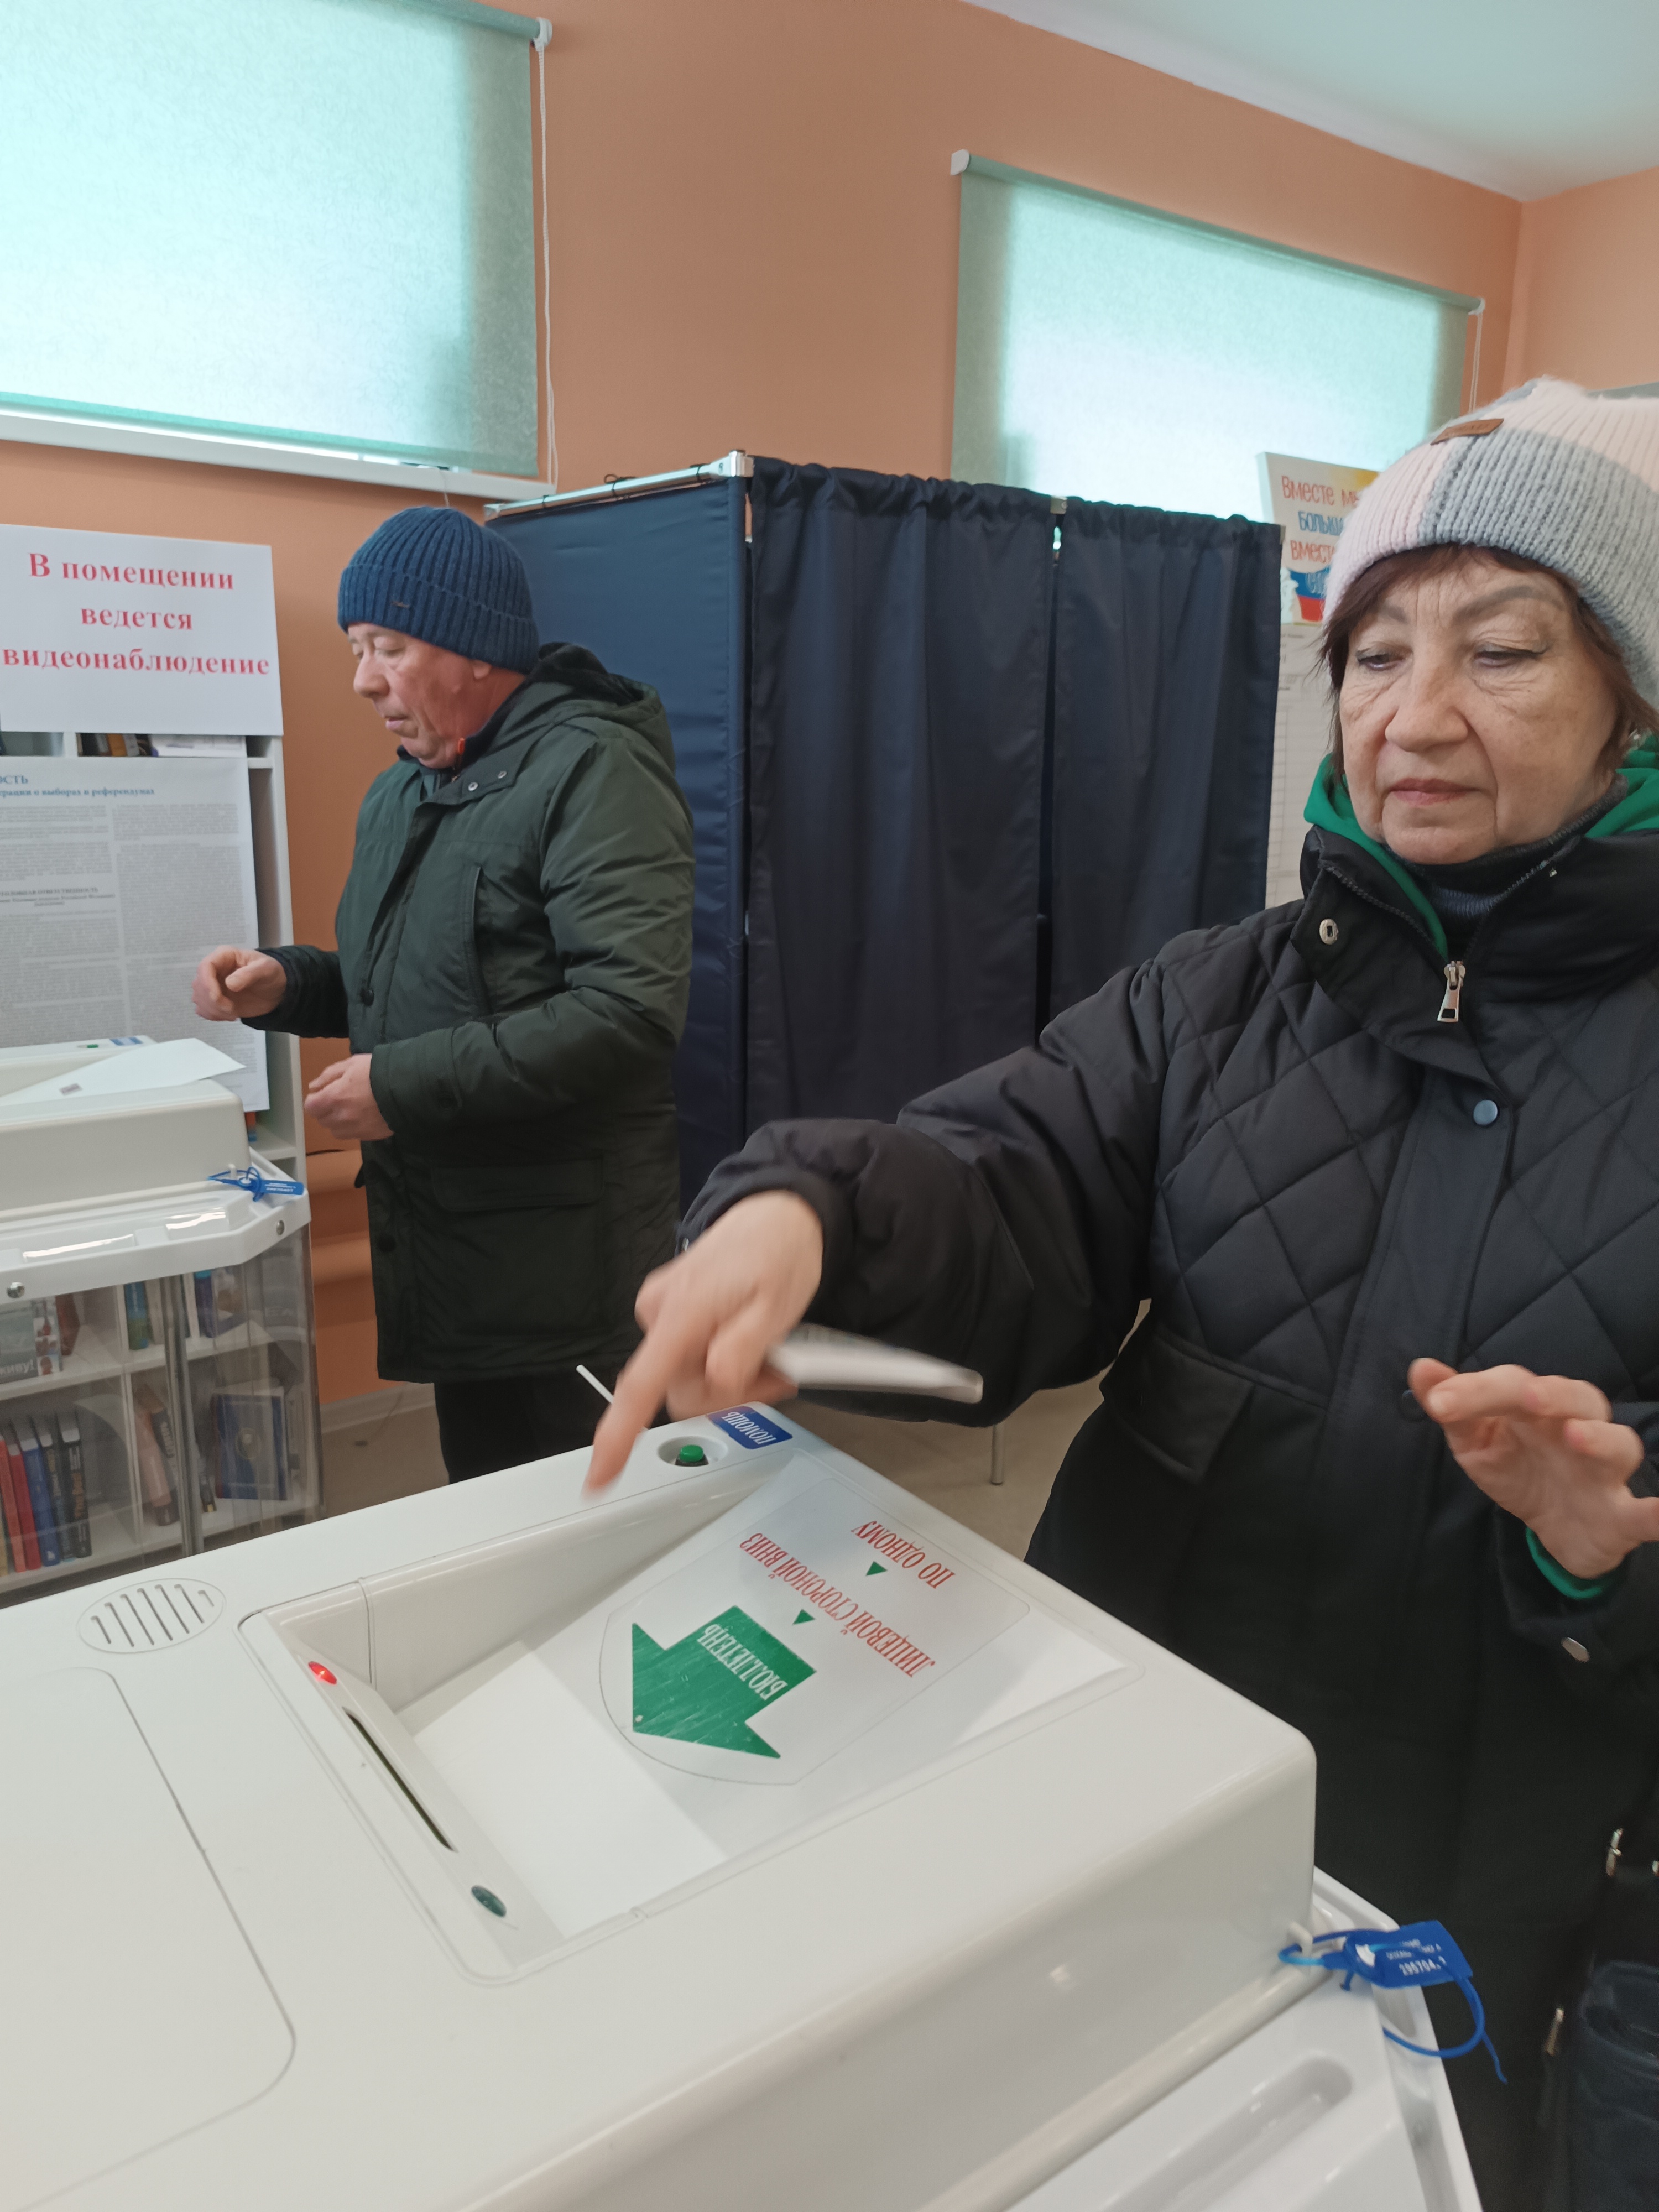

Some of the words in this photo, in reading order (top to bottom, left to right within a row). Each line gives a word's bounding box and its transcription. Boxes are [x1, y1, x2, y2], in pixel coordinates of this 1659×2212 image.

[29, 552, 51, 577] В
[62, 562, 234, 590] помещении
[81, 608, 193, 630] ведется
[2, 648, 269, 675] видеонаблюдение
[721, 1411, 776, 1445] ПОМОЩЬ
[739, 1533, 789, 1568] ВНИЗ
[852, 1520, 927, 1569] ОДНОМУ
[768, 1557, 859, 1621] СТОРОНОЙ
[917, 1562, 956, 1590] ПО
[696, 1624, 787, 1700] БЮЛЛЕТЕНЬ
[840, 1610, 936, 1678] ЛИЦЕВОЙ
